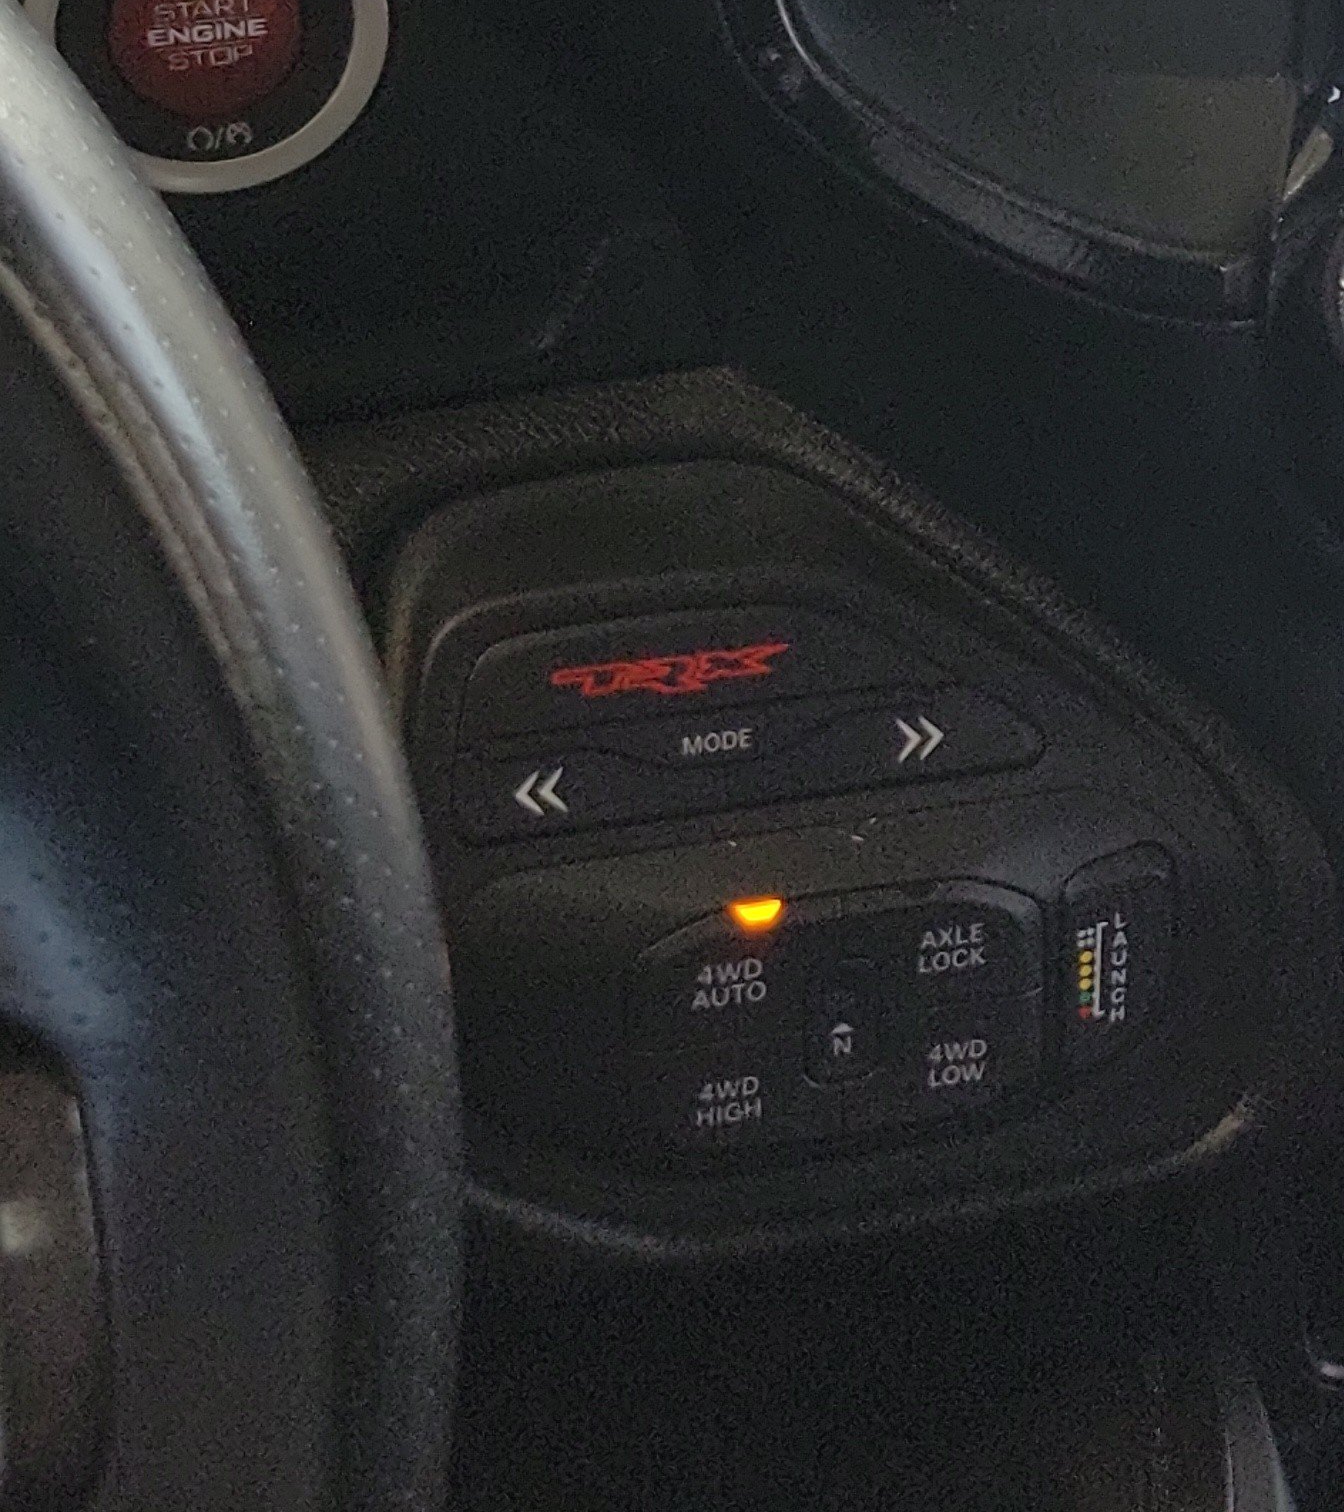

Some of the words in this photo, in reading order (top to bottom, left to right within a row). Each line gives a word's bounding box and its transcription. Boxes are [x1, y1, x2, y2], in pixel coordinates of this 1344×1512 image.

[147, 19, 269, 47] ENGINE
[167, 44, 254, 72] STOP
[681, 728, 753, 757] MODE
[921, 923, 984, 949] AXLE
[696, 956, 764, 984] 4WD
[918, 948, 986, 972] LOCK
[1107, 911, 1127, 1024] LAUNCH
[691, 979, 768, 1011] AUTO
[831, 1034, 853, 1056] N
[929, 1038, 986, 1063] 4WD
[699, 1076, 759, 1100] 4WD
[928, 1062, 985, 1087] LOW
[696, 1097, 762, 1126] HIGH
